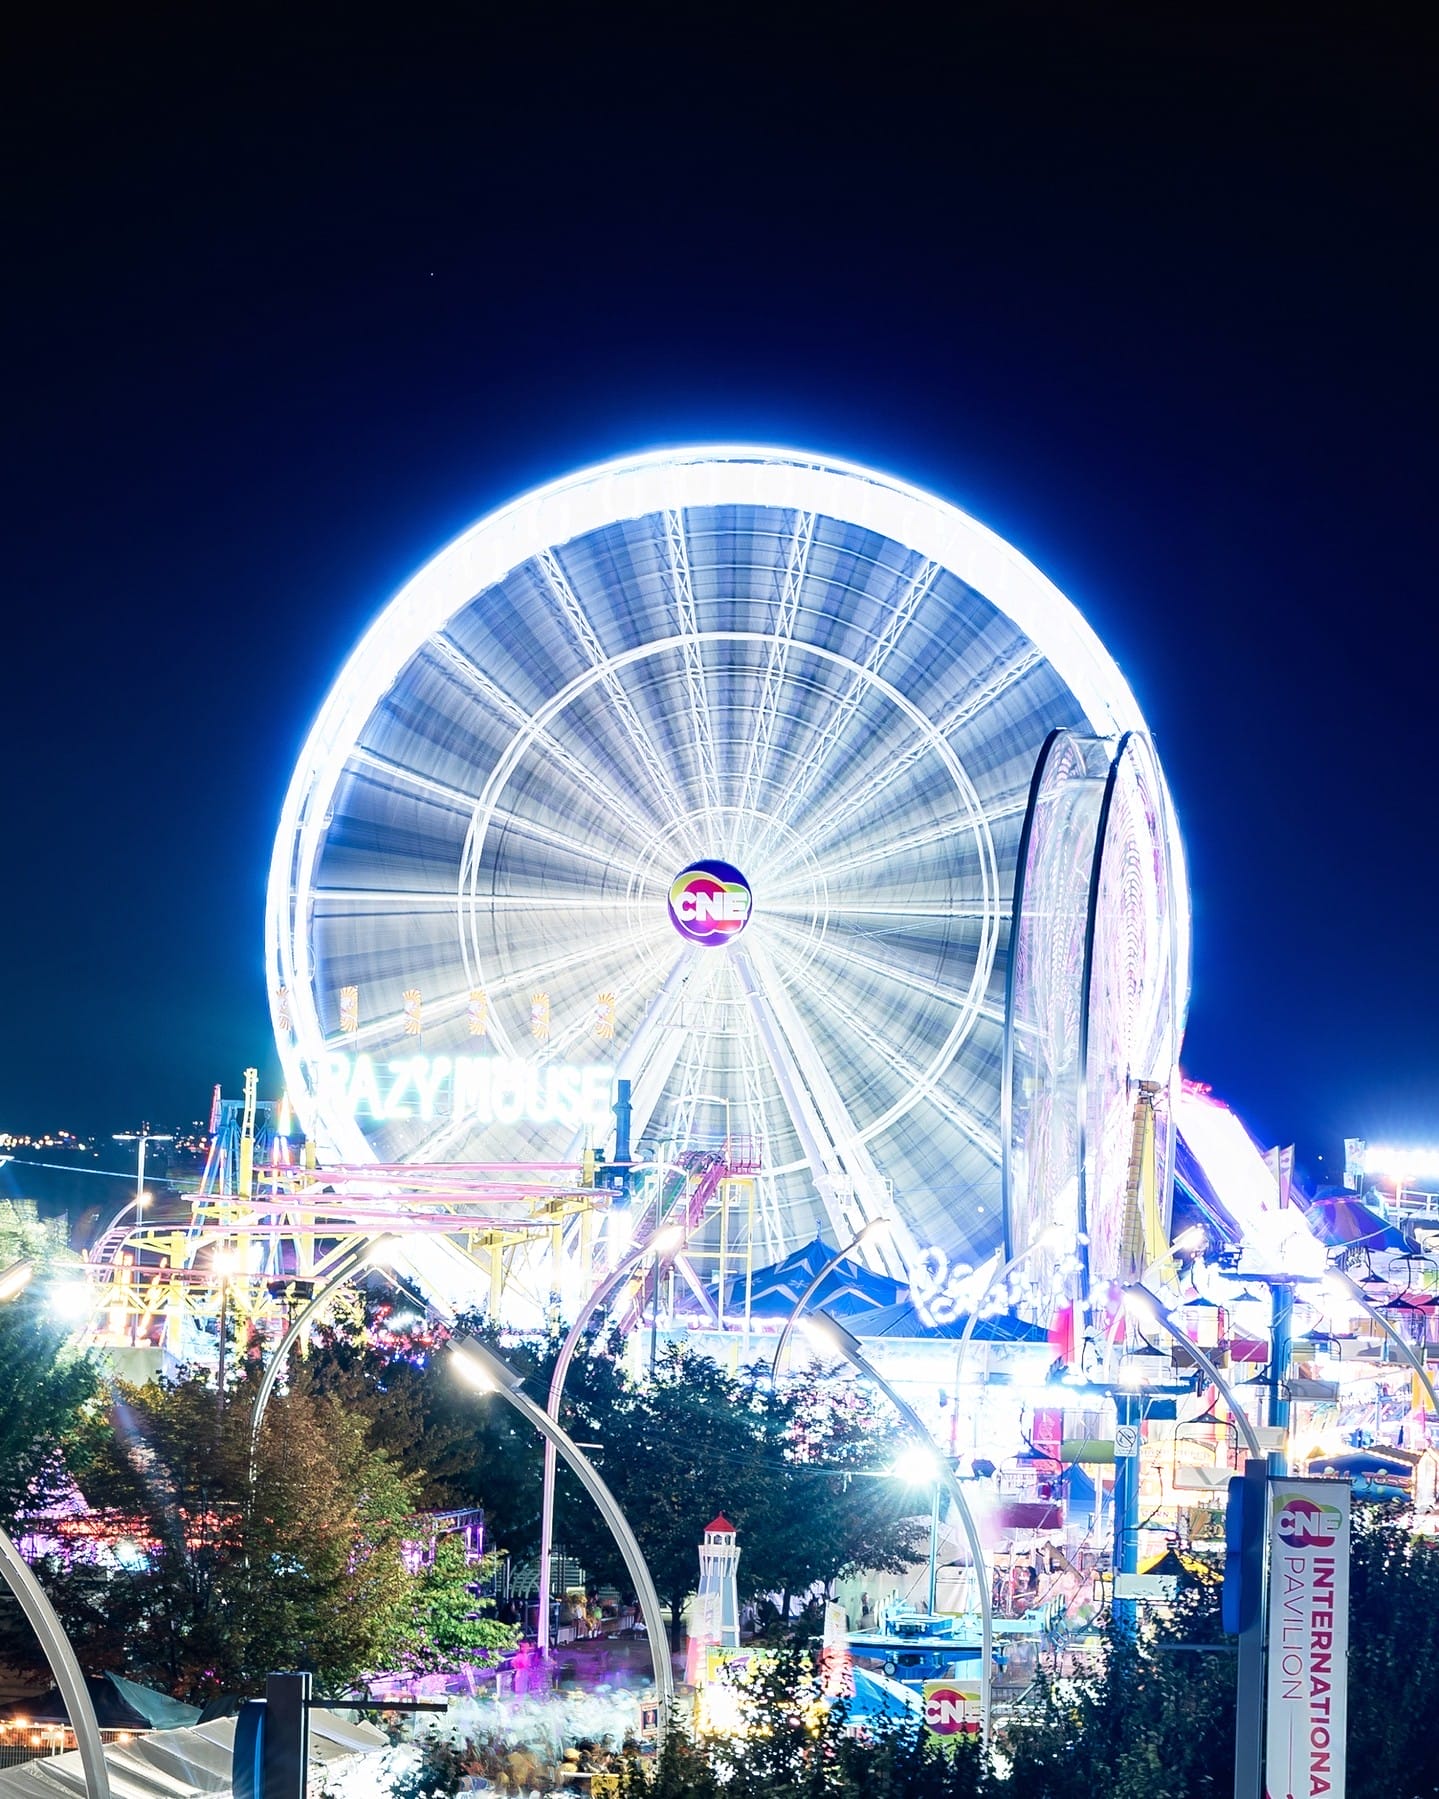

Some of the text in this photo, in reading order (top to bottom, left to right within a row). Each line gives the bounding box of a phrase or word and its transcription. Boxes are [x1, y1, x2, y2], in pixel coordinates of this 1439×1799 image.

[674, 891, 749, 921] CNE
[312, 1052, 615, 1125] RAZY MOUSE
[1276, 1510, 1341, 1536] CNE
[1281, 1557, 1305, 1700] PAVILION
